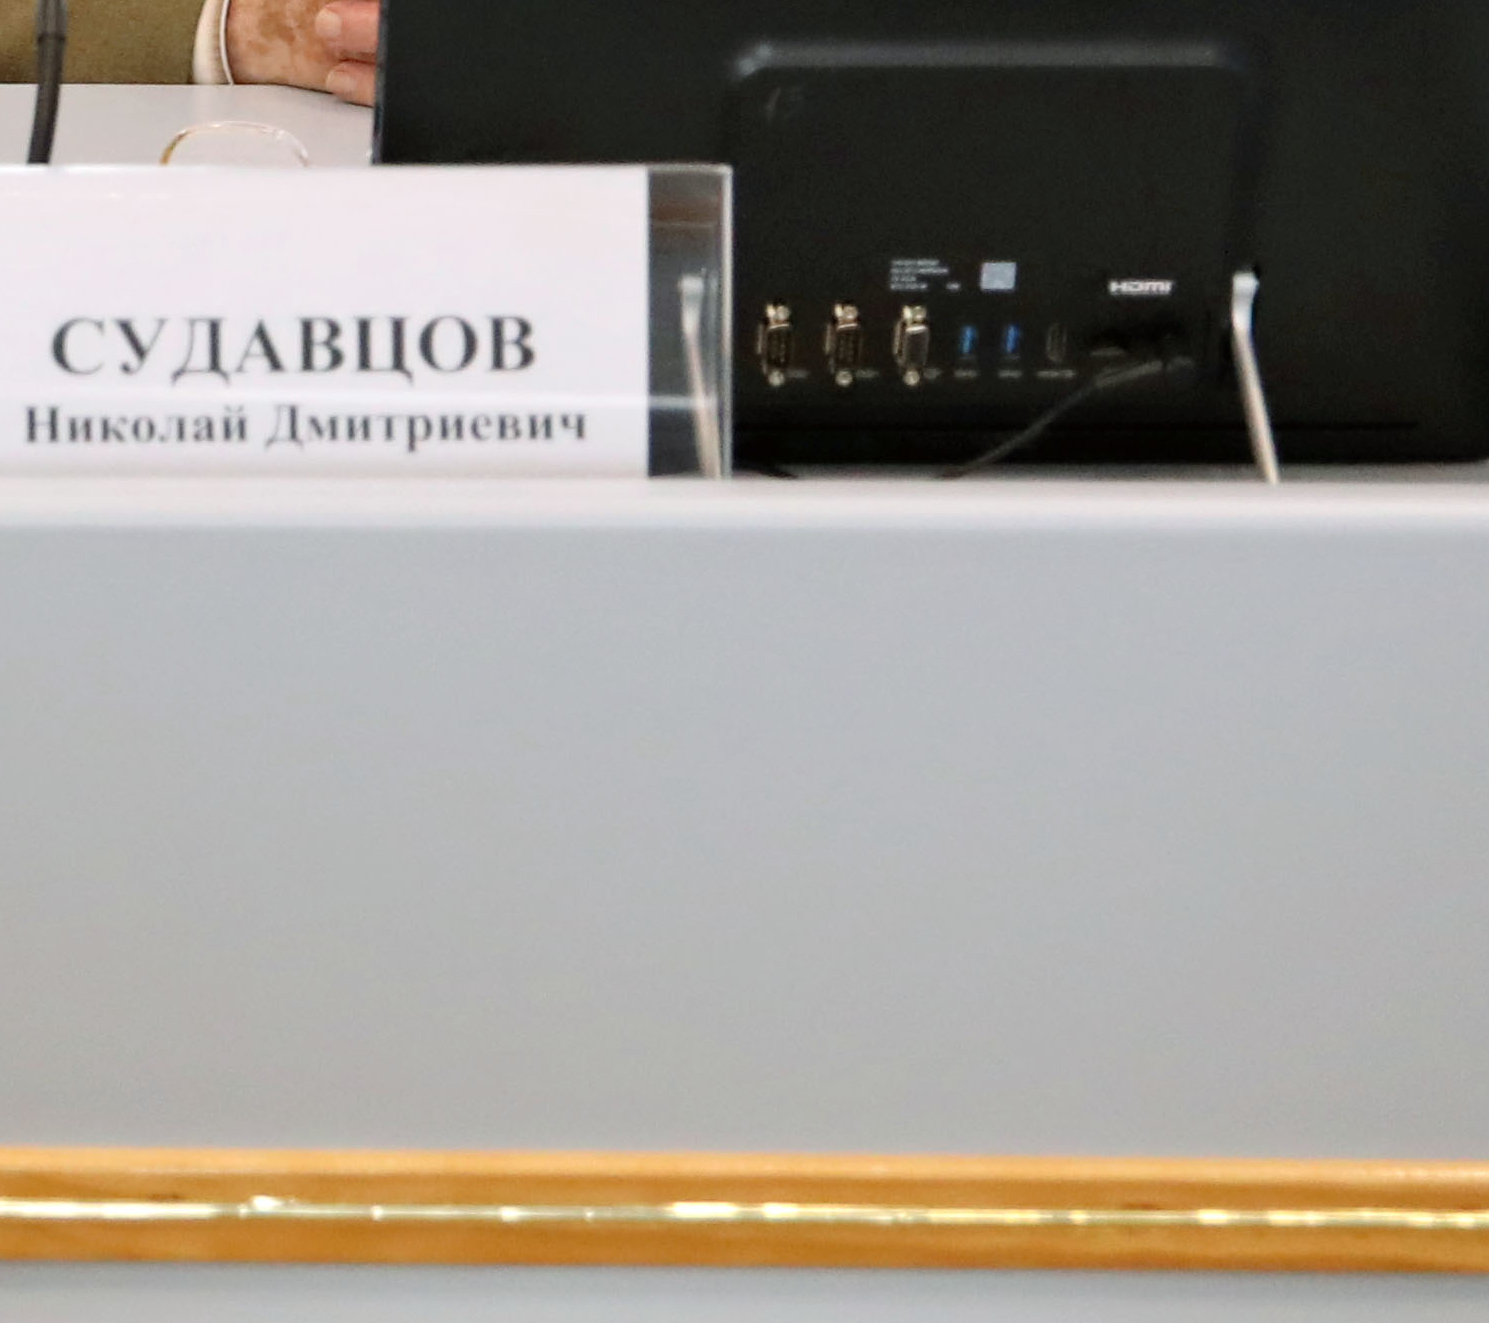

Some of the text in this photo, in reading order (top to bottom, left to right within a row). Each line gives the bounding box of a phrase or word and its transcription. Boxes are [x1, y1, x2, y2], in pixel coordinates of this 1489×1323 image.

[50, 315, 536, 384] СУДАВЦОВ
[23, 404, 588, 452] Николай Дмитриевич
